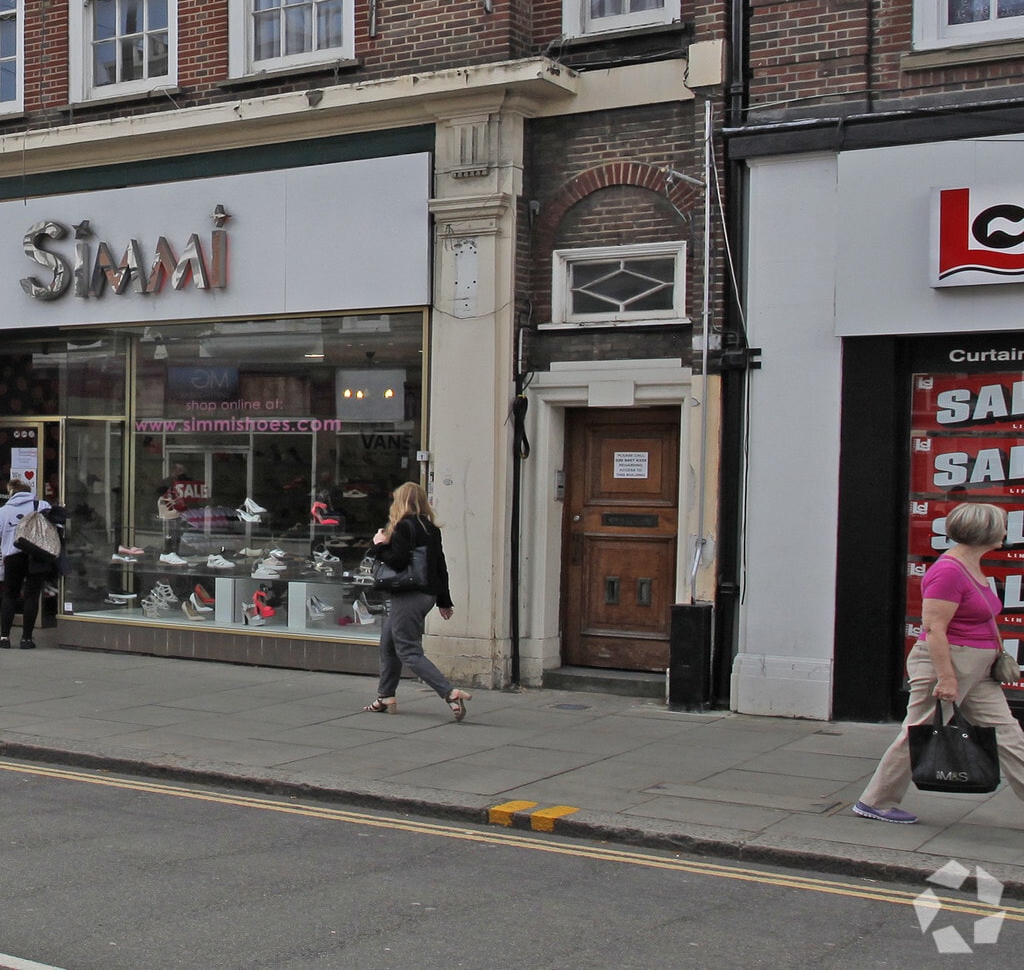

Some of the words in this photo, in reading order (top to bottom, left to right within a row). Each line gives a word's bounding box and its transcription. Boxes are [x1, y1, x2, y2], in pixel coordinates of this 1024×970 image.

[186, 399, 217, 412] shop
[221, 399, 261, 410] online
[265, 398, 284, 411] at:
[135, 418, 342, 432] www.simmishoes.com
[175, 483, 209, 500] SALE
